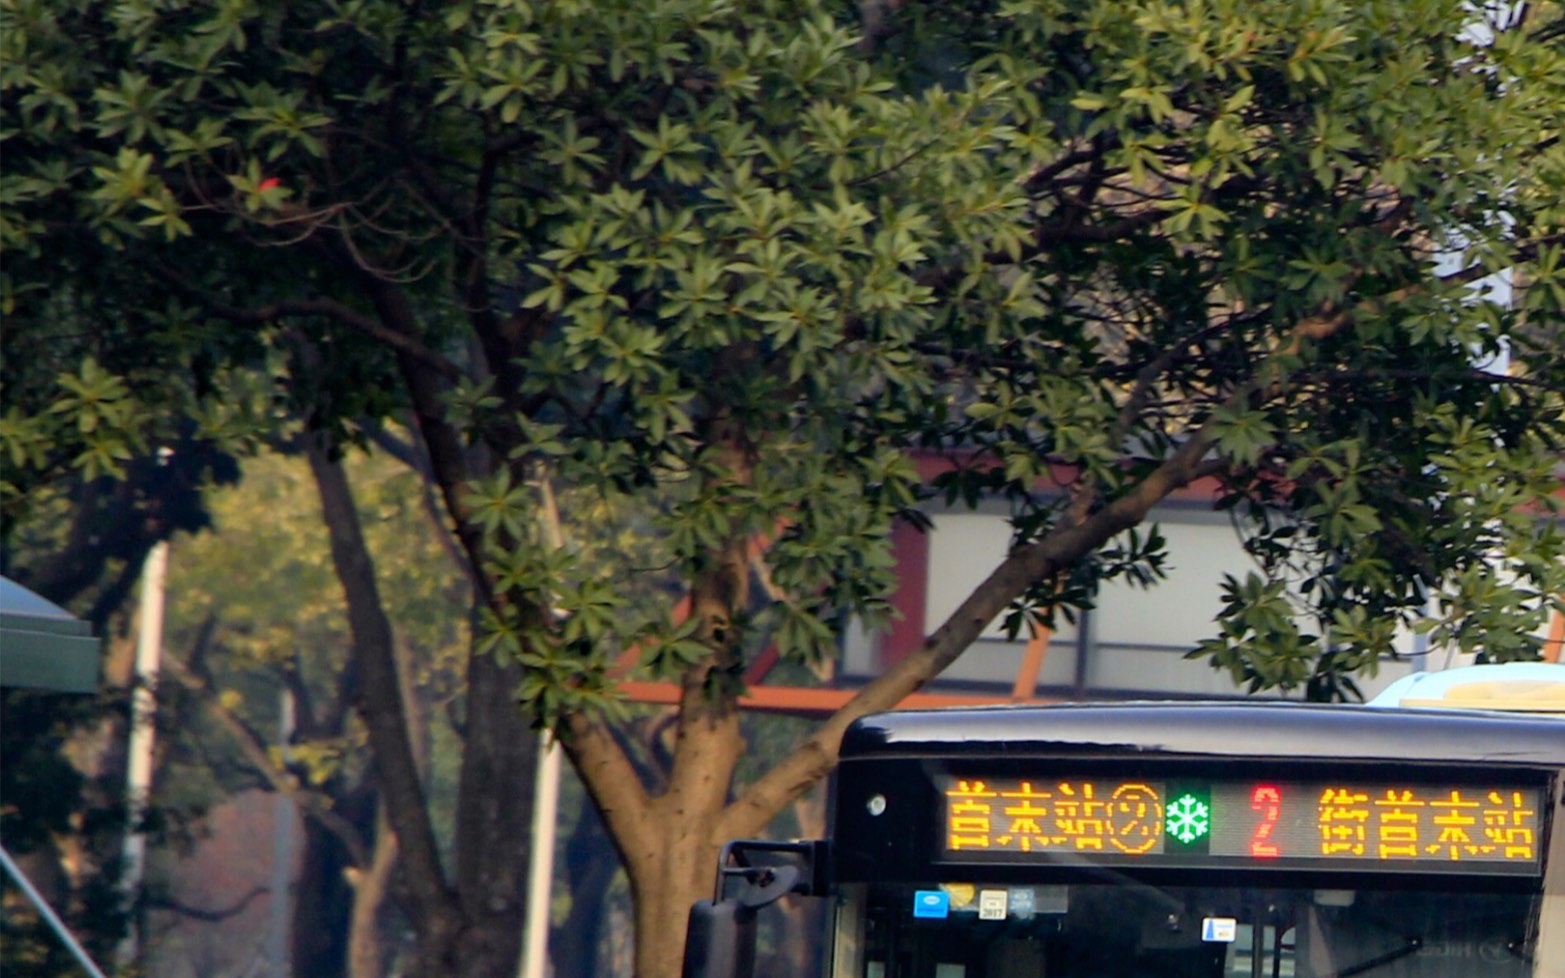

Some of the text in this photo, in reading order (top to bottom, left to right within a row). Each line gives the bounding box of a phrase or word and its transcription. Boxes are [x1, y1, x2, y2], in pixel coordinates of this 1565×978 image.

[1251, 784, 1281, 858] 2
[1318, 788, 1534, 860] 街首末站
